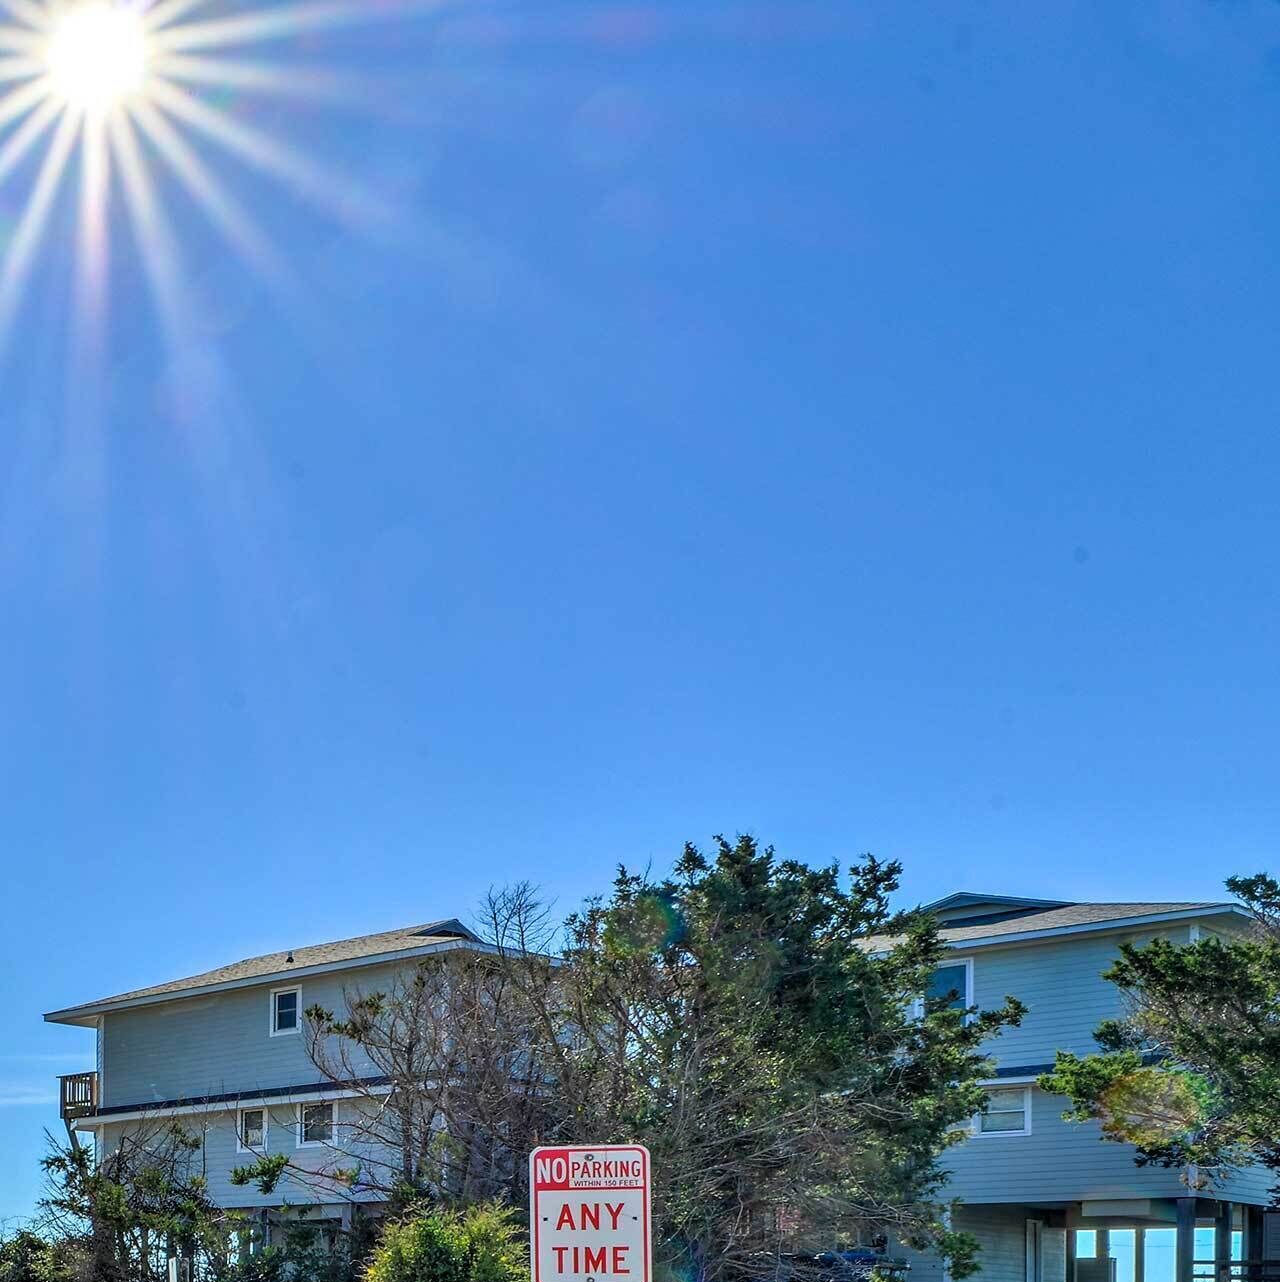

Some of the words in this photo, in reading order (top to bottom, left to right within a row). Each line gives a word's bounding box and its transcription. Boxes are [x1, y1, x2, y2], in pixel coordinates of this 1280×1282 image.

[536, 1157, 568, 1184] NO
[571, 1160, 640, 1178] PARKING
[556, 1203, 625, 1231] ANY
[552, 1246, 630, 1274] TIME
